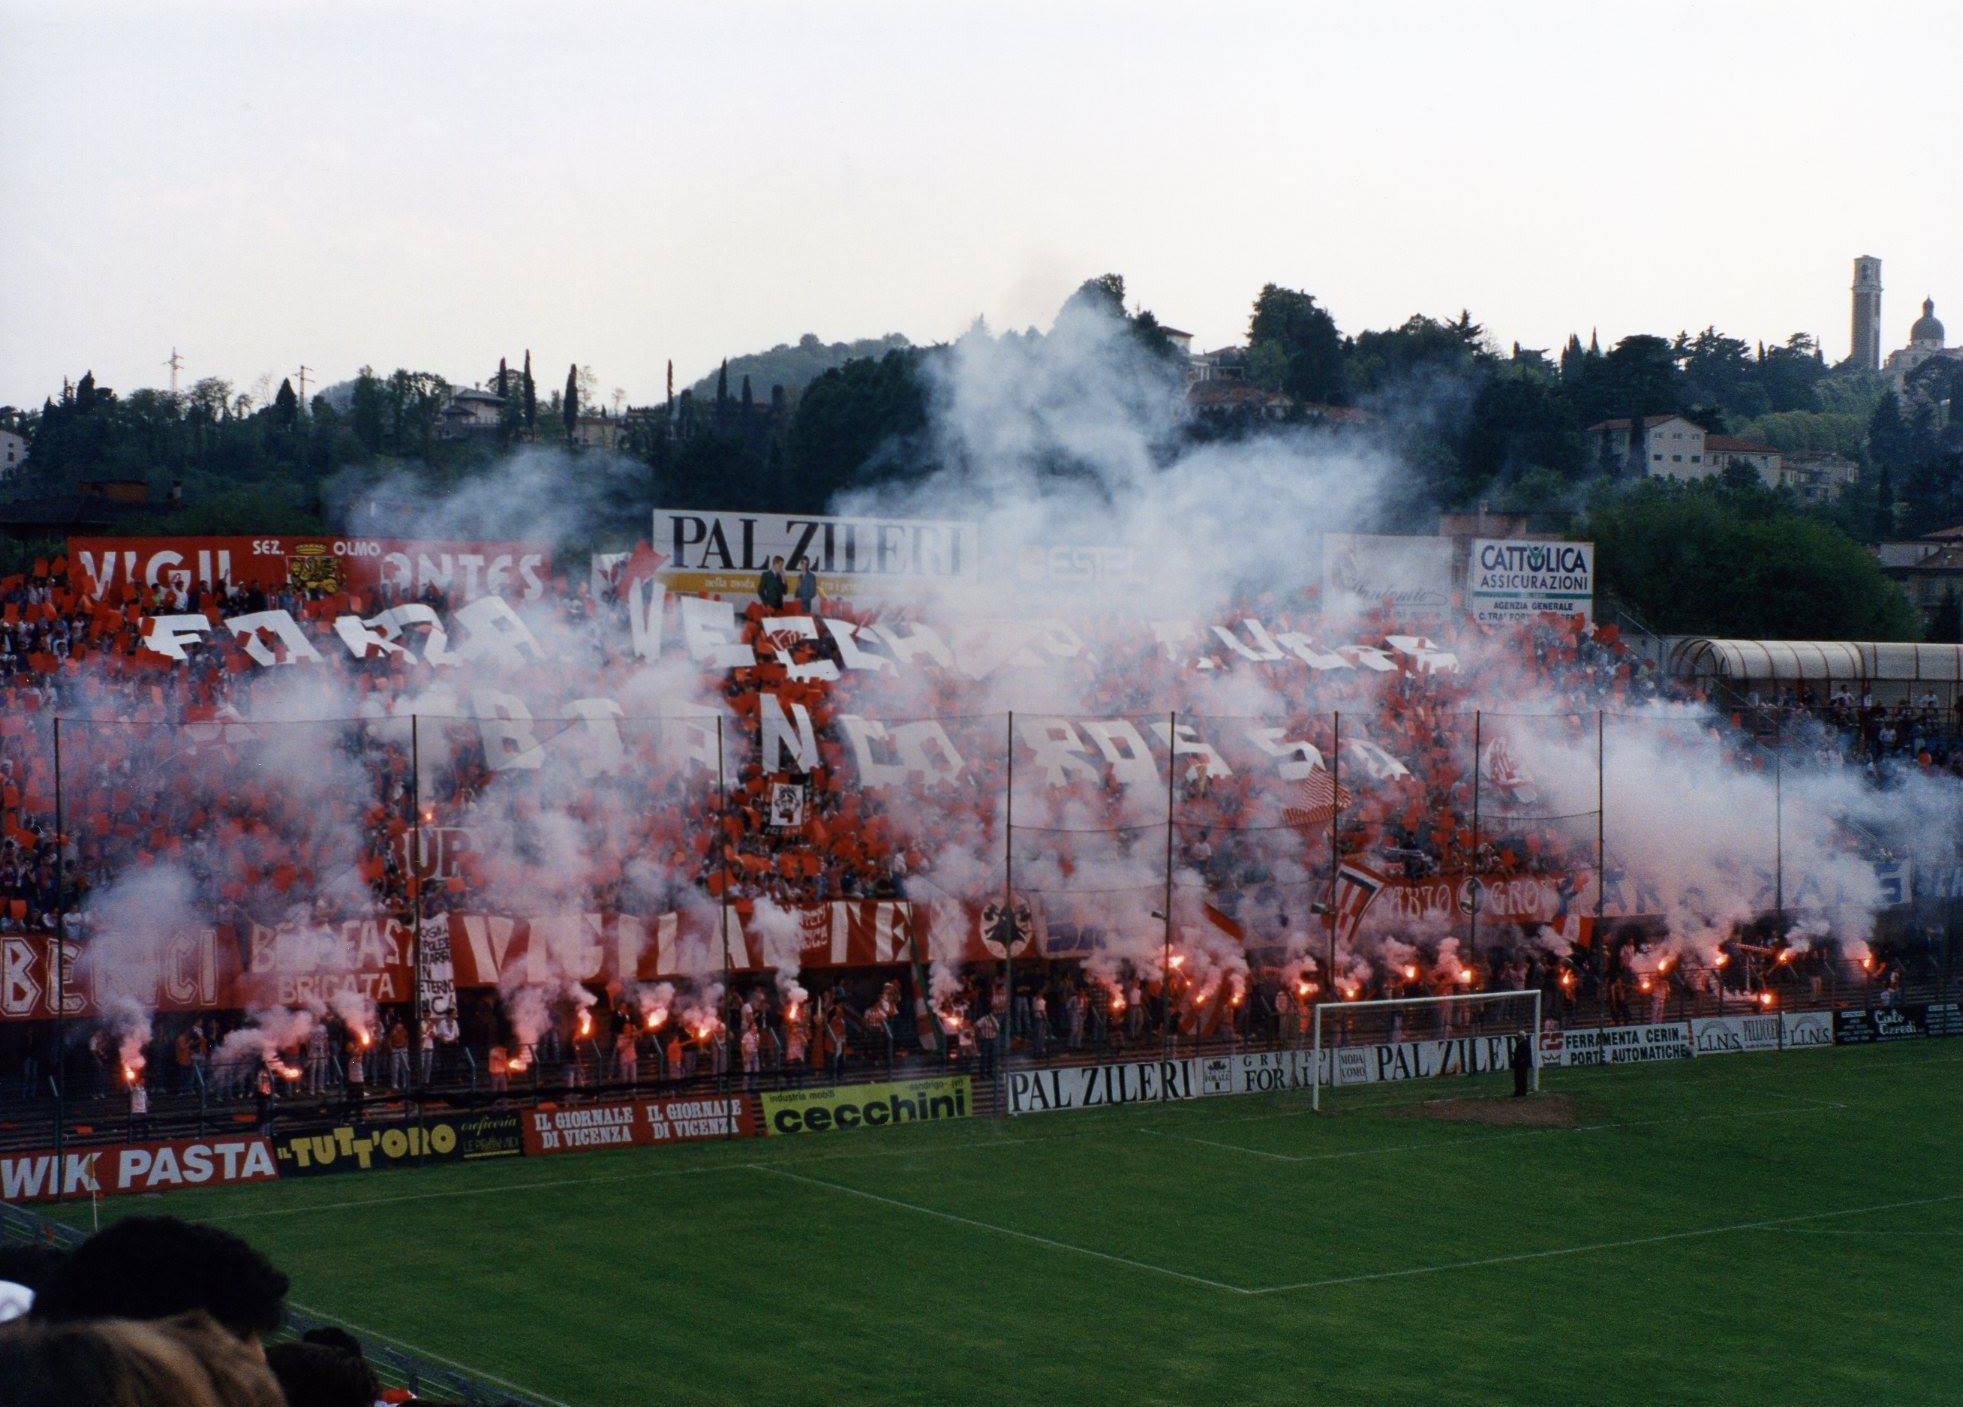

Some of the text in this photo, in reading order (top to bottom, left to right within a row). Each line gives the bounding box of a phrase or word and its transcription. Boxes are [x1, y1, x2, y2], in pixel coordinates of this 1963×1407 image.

[252, 540, 381, 557] SEZ. OLMO
[669, 515, 770, 570] PAL
[1481, 544, 1587, 573] CATTOLICA
[1480, 574, 1588, 590] ASSICURAZIONI
[1494, 601, 1574, 611] AGENZIA GENERALE
[277, 971, 395, 1003] BRIGATA
[1565, 1030, 1640, 1050] FERRAMENTA
[1374, 1043, 1430, 1081] PAL
[1570, 1043, 1688, 1065] PORTE AUTOMATICHE
[1009, 1060, 1193, 1112] PAL ZILERI
[1245, 1066, 1329, 1092] FORALL
[534, 1107, 634, 1131] IL GIORNALE
[646, 1105, 664, 1122] IL
[774, 1088, 966, 1134] cecchini
[541, 1125, 633, 1149] DI VICENZA
[652, 1122, 671, 1139] DI
[118, 1141, 276, 1189] PASTA
